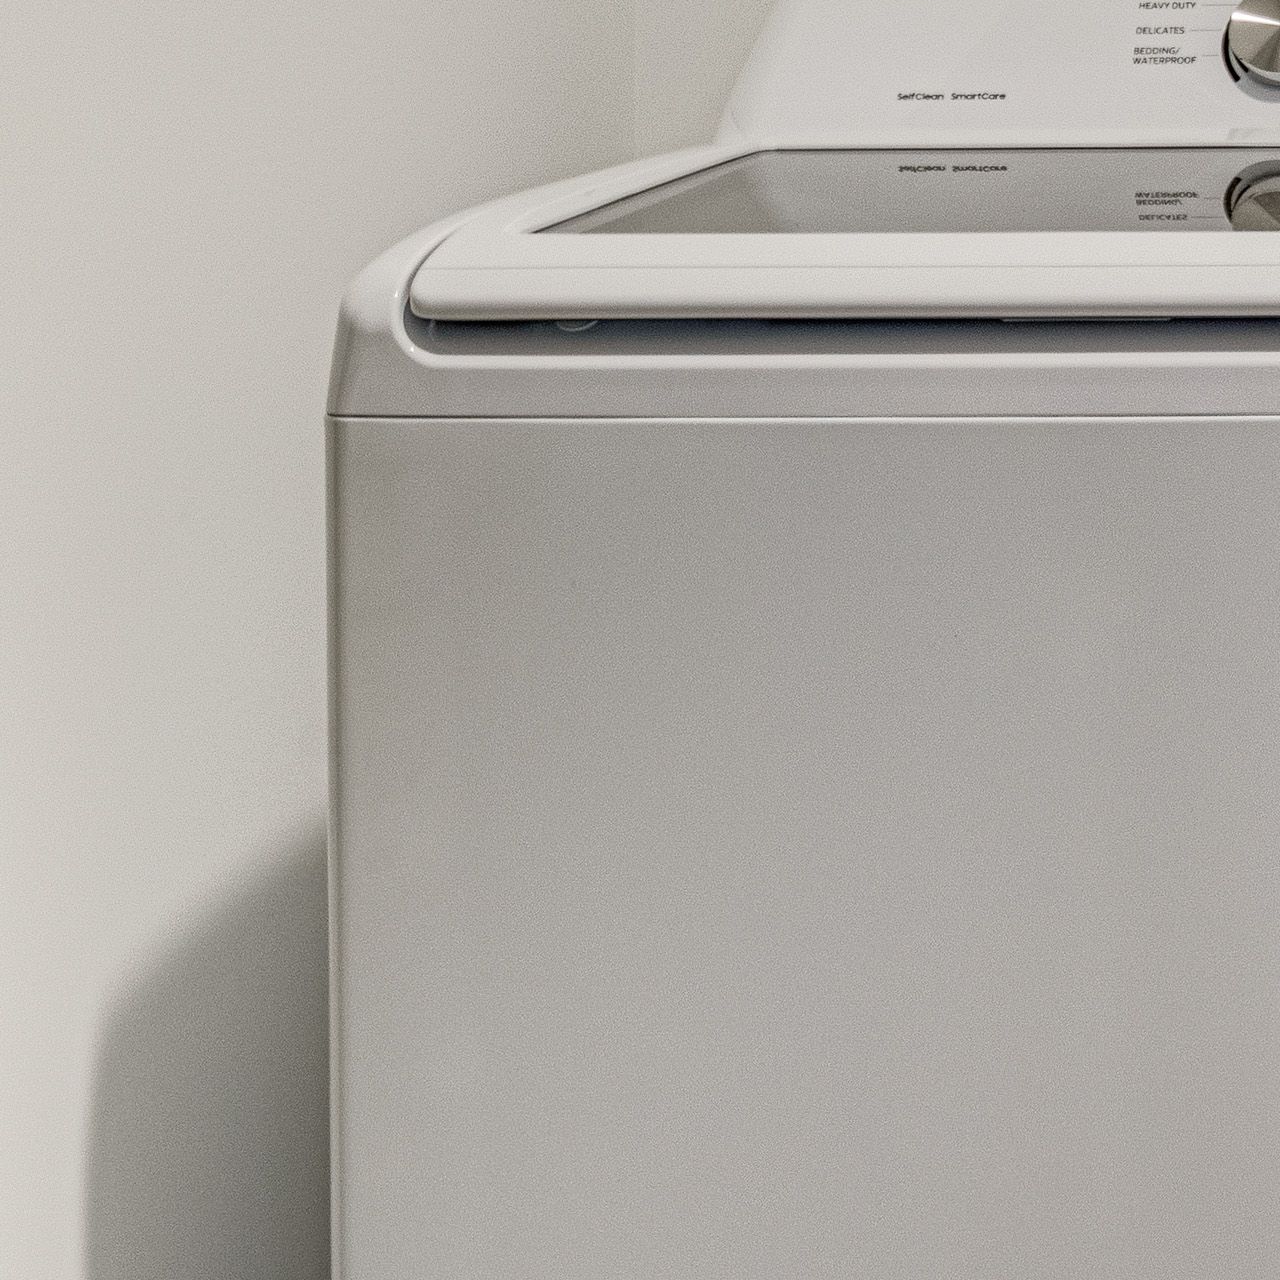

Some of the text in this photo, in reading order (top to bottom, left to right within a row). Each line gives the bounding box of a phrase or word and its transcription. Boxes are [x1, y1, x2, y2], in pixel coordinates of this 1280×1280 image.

[1138, 1, 1197, 10] HEAVY DUTY
[1135, 26, 1185, 35] DELICATES
[1133, 47, 1180, 56] BEDDING/
[1132, 56, 1197, 65] WATERPROOF
